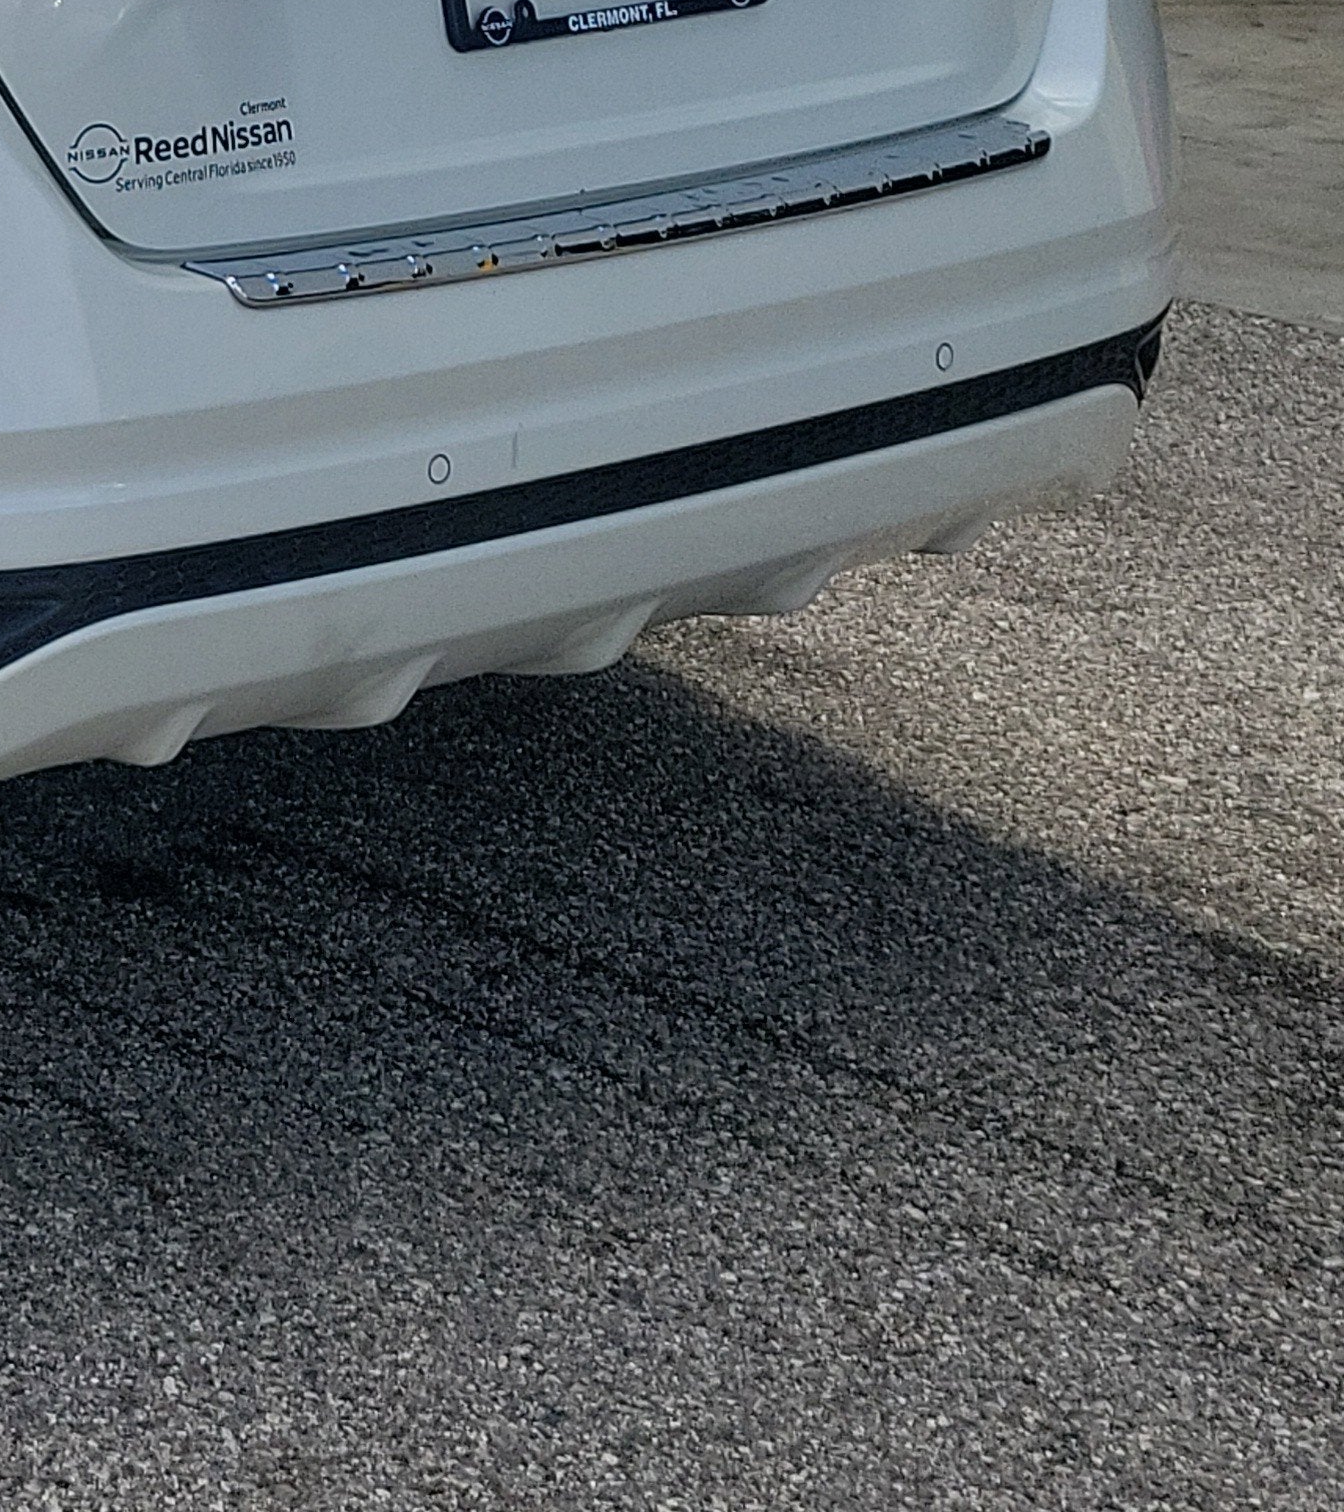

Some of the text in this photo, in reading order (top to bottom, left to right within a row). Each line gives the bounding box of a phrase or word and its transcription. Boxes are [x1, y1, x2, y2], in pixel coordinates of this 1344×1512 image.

[568, 4, 653, 32] CLERMONT,
[239, 97, 287, 116] Clermont
[67, 144, 130, 163] NISSAN
[133, 118, 293, 165] Reed Nissan
[115, 149, 296, 193] Serving Central Florida since 1950
